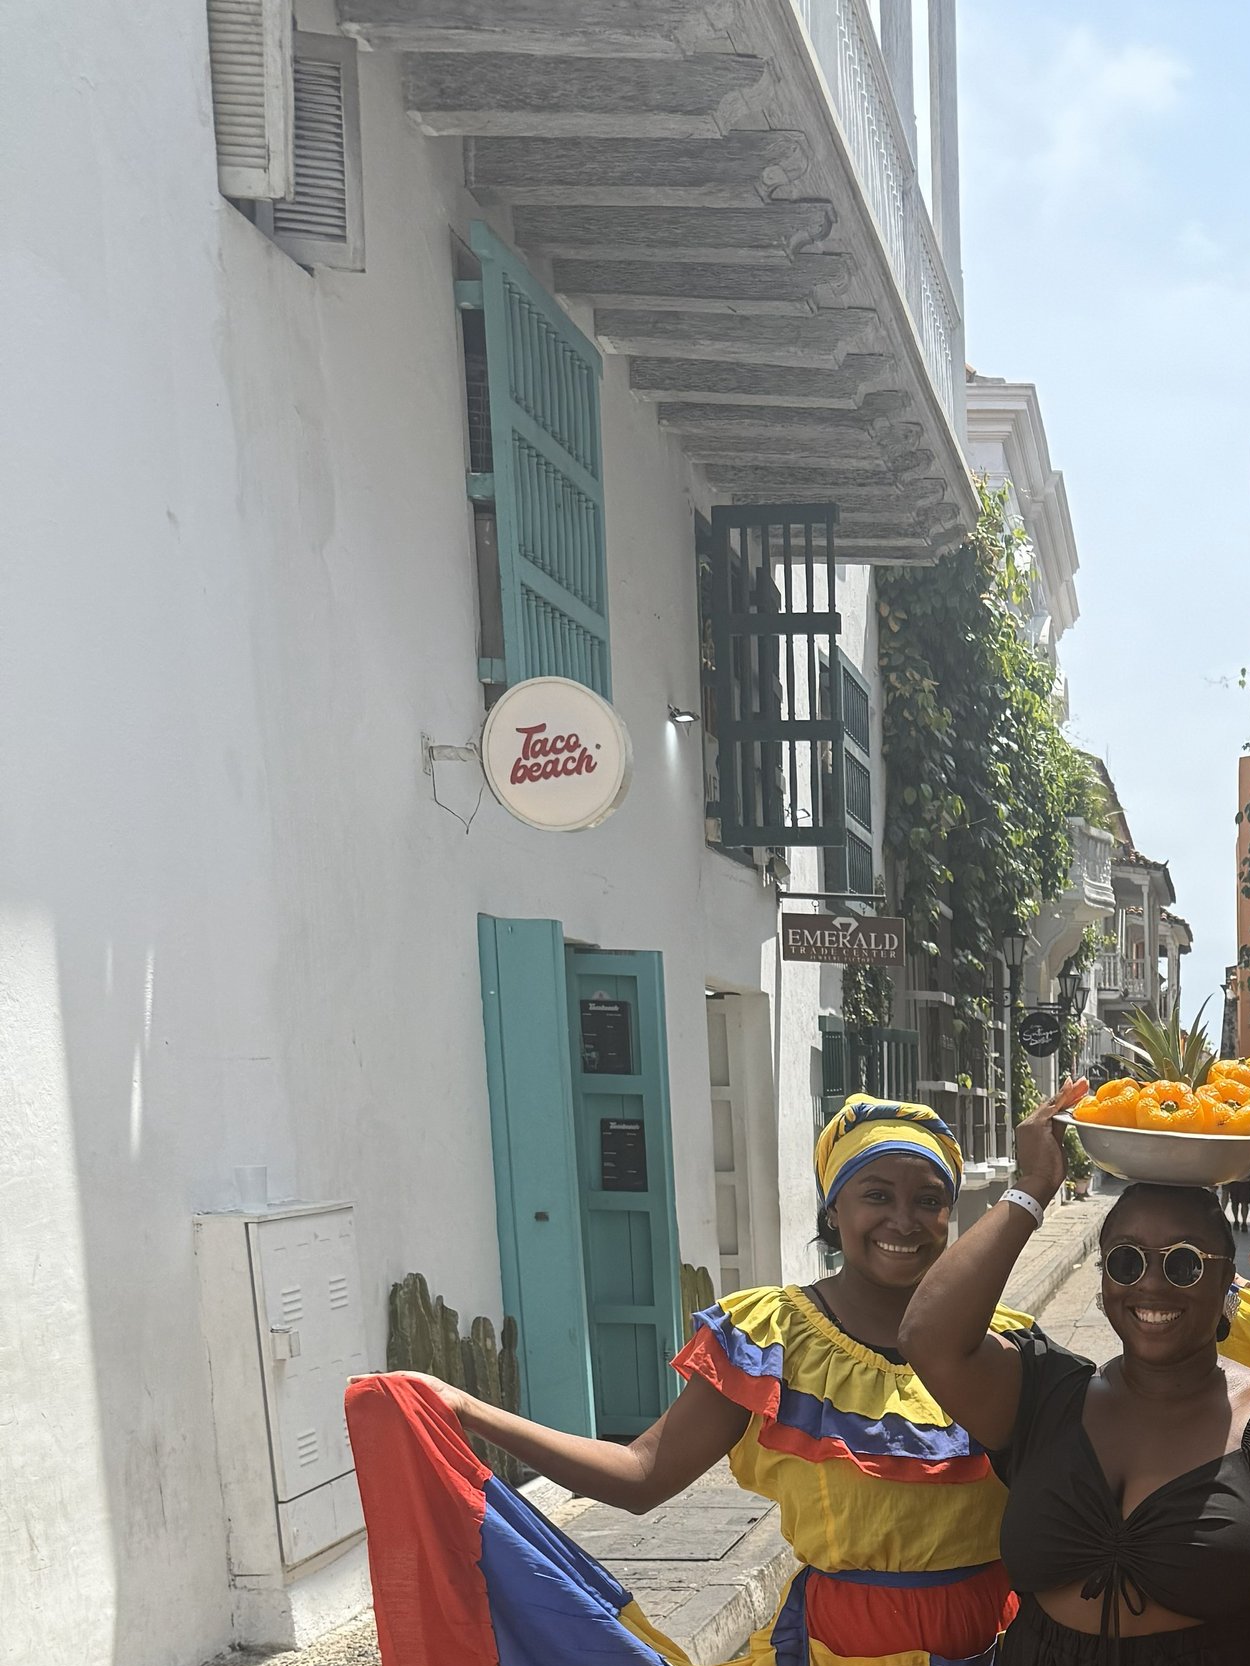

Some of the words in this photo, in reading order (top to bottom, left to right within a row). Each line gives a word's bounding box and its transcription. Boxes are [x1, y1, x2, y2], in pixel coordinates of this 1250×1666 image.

[515, 722, 581, 761] Taco
[510, 746, 598, 785] beach
[788, 928, 899, 951] EMERALD
[790, 946, 838, 956] TRADE
[843, 947, 897, 959] CENTER
